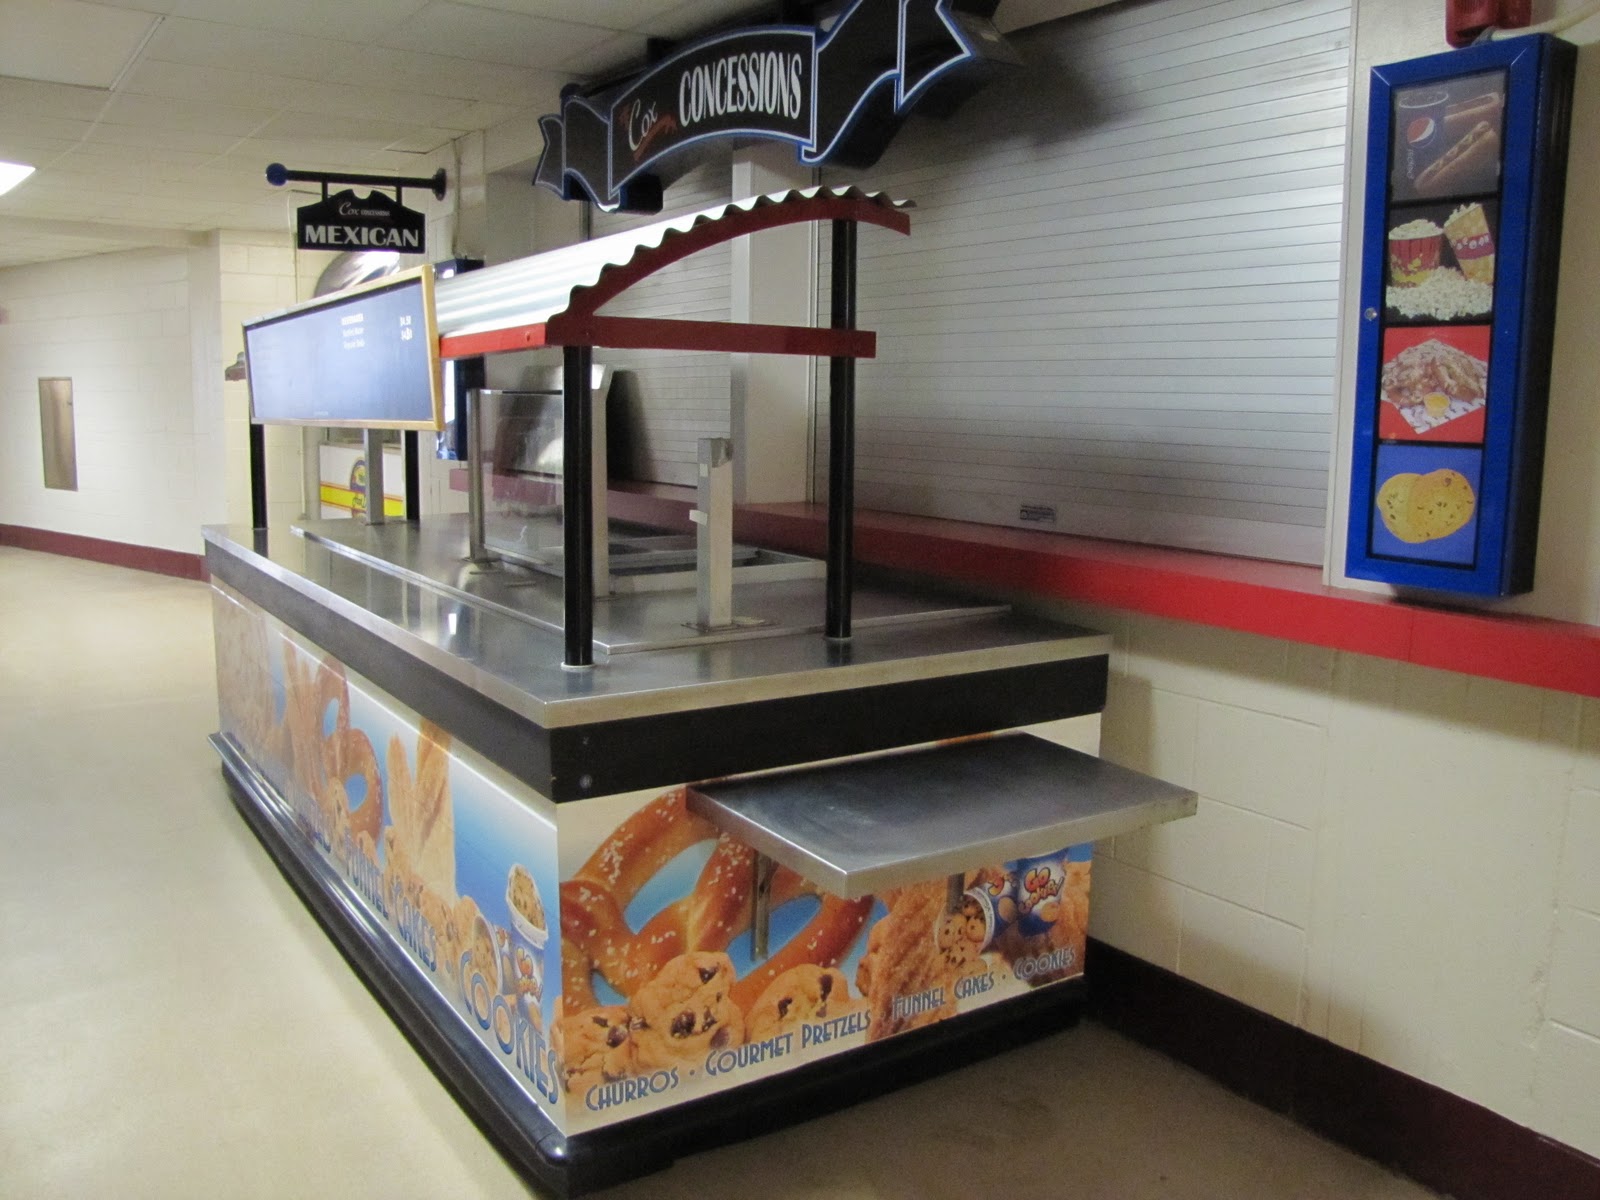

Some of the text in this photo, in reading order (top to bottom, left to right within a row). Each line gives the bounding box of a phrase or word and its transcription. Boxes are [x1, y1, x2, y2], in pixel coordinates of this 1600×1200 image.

[628, 51, 802, 151] Cox CONCESSIONS
[305, 224, 419, 247] MEXICAN
[339, 201, 360, 216] Cox
[460, 951, 559, 1104] COOKIES
[585, 947, 1076, 1112] CHURROS GOURMET PRETZELS FUNNEL CAKES COOKIES
